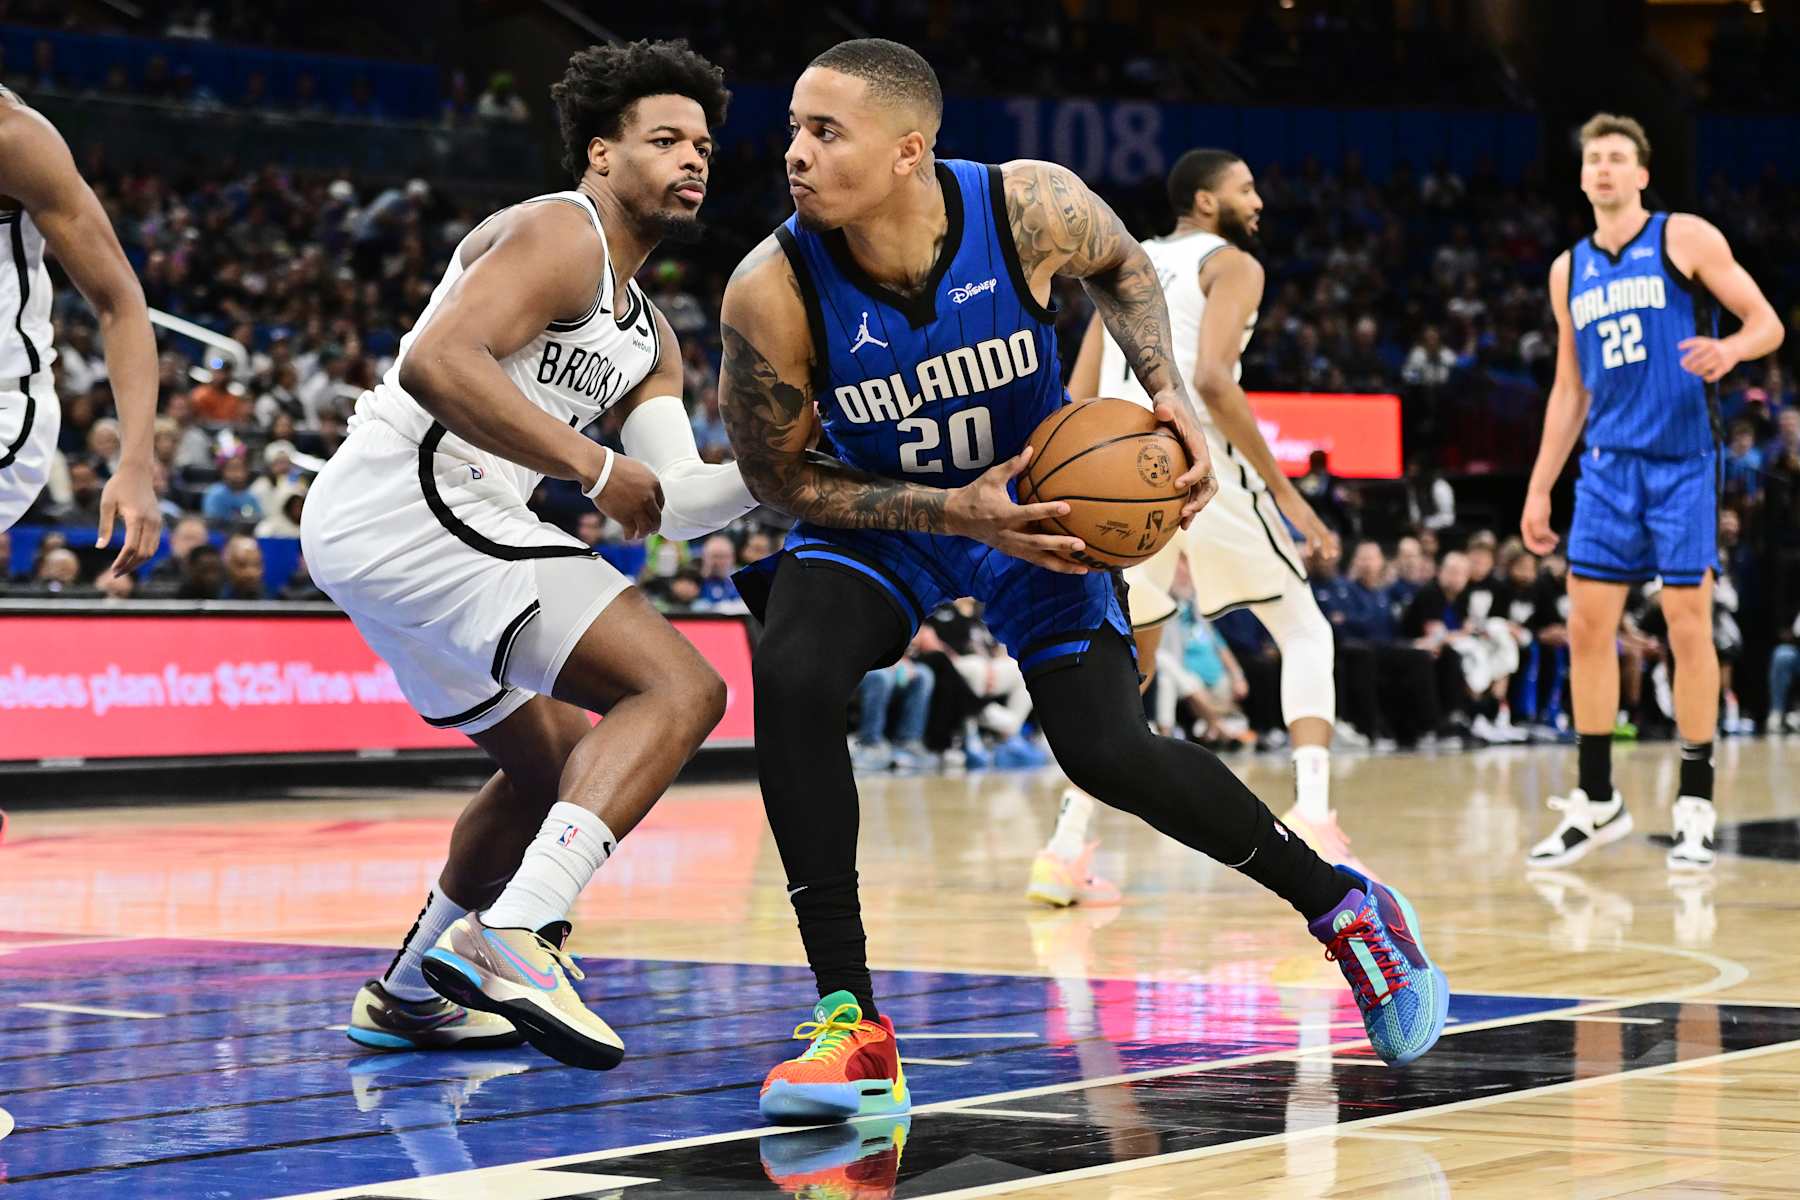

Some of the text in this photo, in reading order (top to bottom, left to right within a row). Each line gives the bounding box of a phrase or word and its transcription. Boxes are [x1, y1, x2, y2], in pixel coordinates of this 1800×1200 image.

[1007, 99, 1165, 183] 108
[947, 278, 997, 304] Disney
[1571, 275, 1666, 330] ORLANDO
[1597, 313, 1647, 370] 22
[537, 341, 630, 409] BROOKL
[834, 329, 1039, 424] ORLANDO
[897, 406, 995, 473] 20
[89, 663, 164, 717] plan
[163, 661, 213, 706] for
